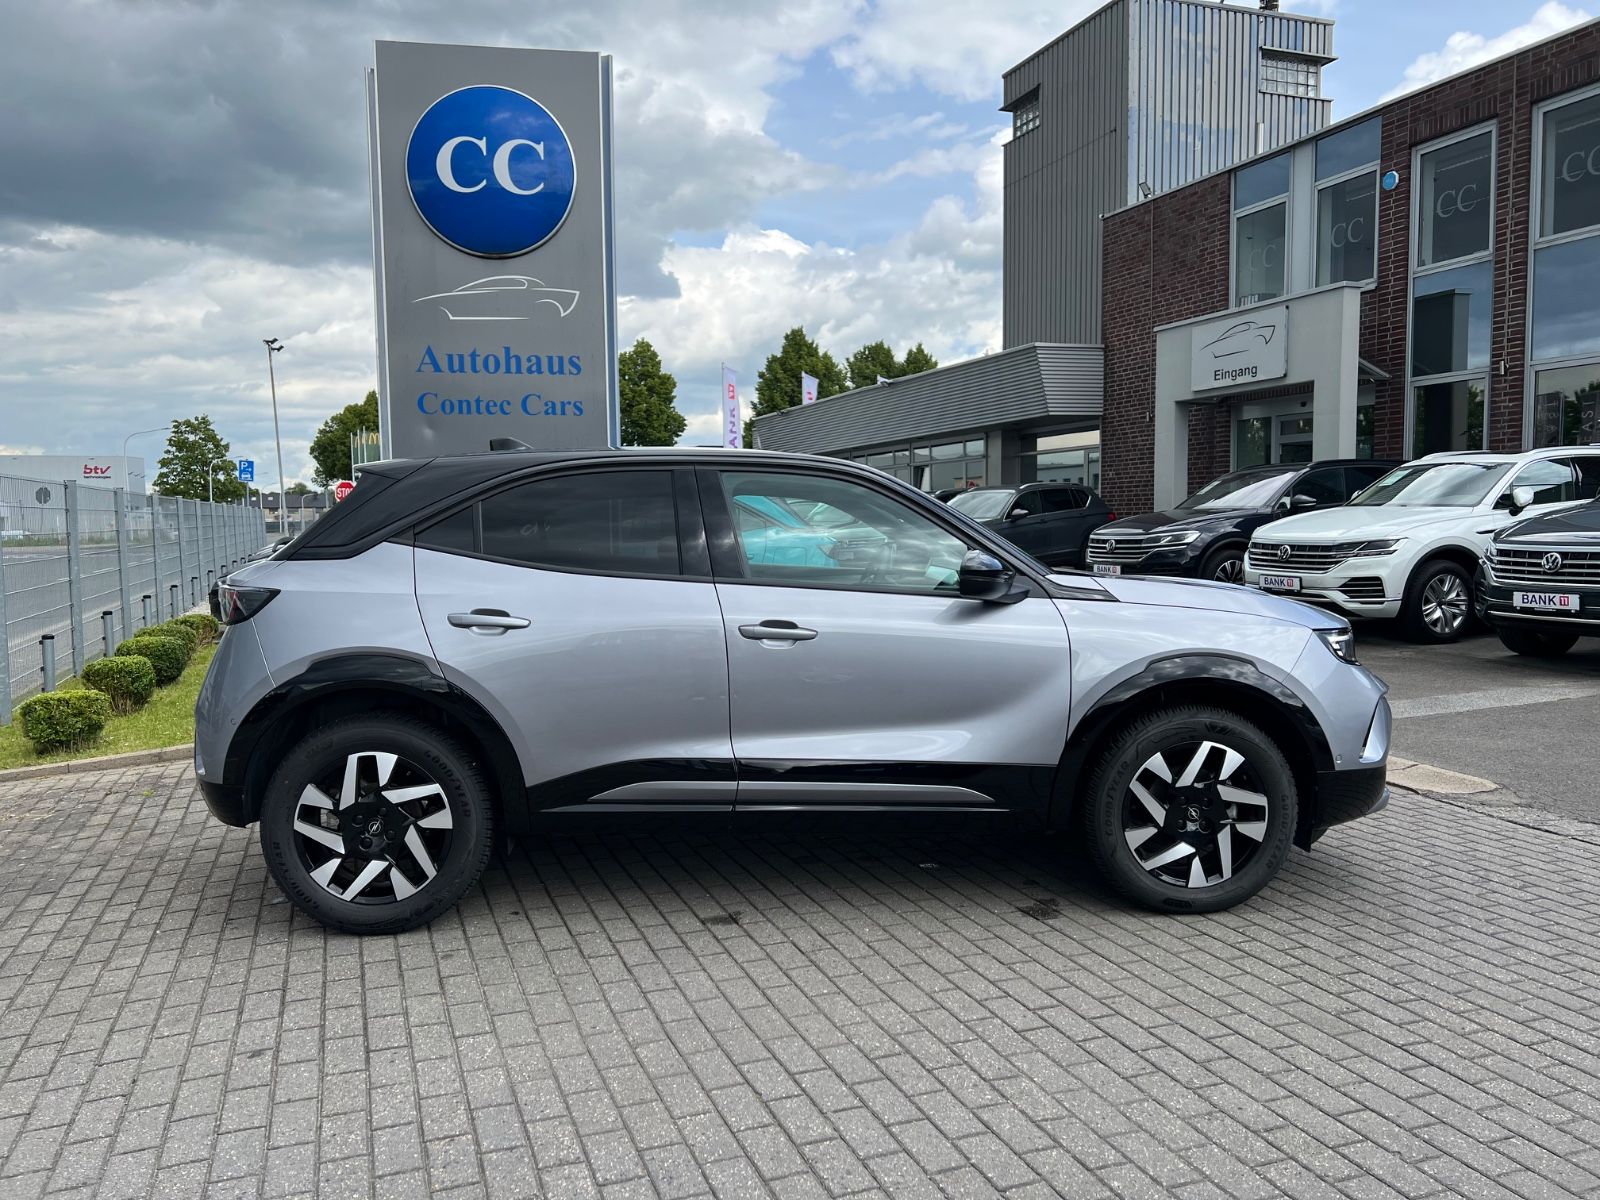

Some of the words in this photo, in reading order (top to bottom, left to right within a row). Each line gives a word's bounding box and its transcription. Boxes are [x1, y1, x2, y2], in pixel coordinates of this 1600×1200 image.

[436, 135, 545, 195] CC
[1436, 184, 1477, 218] CC
[1331, 217, 1364, 247] CC
[1250, 244, 1276, 271] CC
[416, 344, 582, 376] Autohaus
[1213, 365, 1258, 381] Eingang
[417, 392, 512, 416] Contec
[520, 393, 584, 417] Cars
[728, 407, 738, 448] ANK
[83, 464, 112, 475] btv
[241, 462, 248, 470] P
[337, 488, 353, 498] STO
[1097, 566, 1111, 574] BANK
[1264, 576, 1287, 587] BANK
[1521, 594, 1557, 606] BANK
